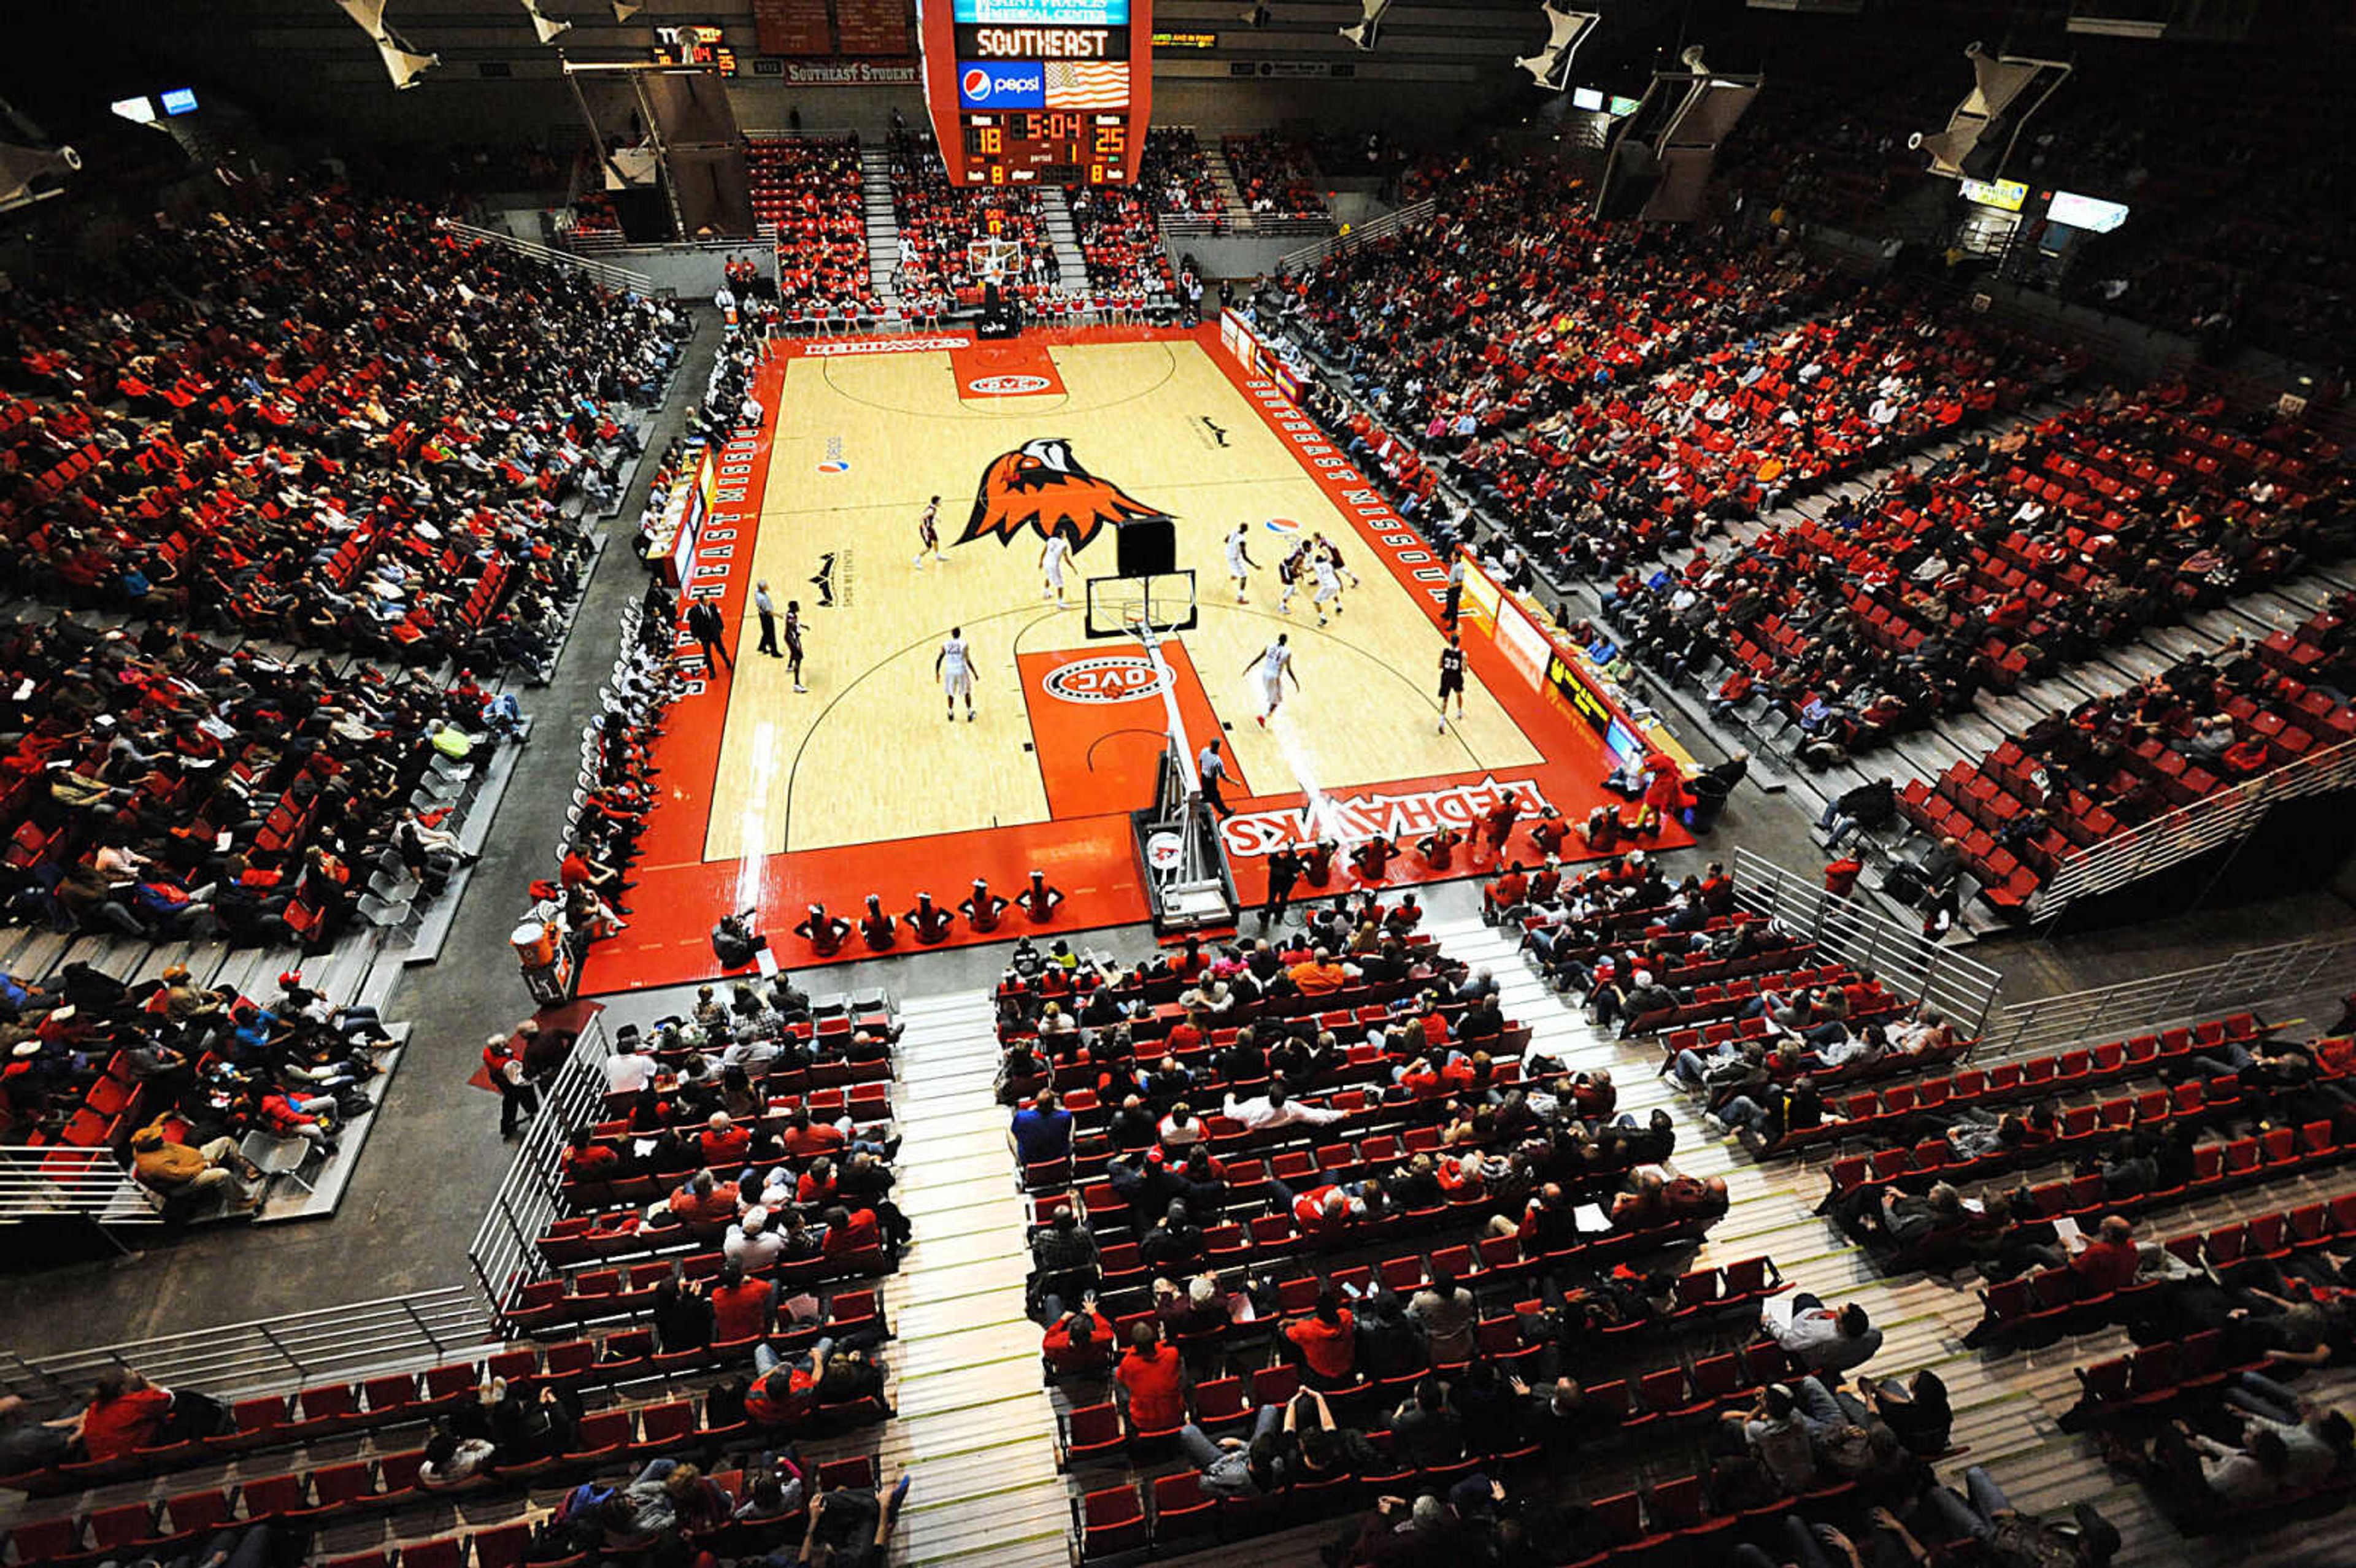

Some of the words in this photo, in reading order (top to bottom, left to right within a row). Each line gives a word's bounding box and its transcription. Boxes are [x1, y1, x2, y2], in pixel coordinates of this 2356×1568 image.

[977, 29, 1108, 56] SOUTHEAST
[861, 63, 915, 80] STUDENT
[995, 76, 1039, 93] pepsi
[1026, 114, 1080, 139] 5:04
[980, 128, 1001, 153] 18
[1095, 128, 1124, 152] 25
[991, 166, 1004, 185] 8
[1091, 164, 1103, 183] 8
[805, 338, 971, 355] REDHAWKS
[1245, 380, 1358, 482] SOUTHEAST
[714, 420, 761, 503] MISSOU
[1444, 657, 1459, 671] 33
[1078, 669, 1146, 690] OVC
[1222, 775, 1555, 855] REDHAWKS
